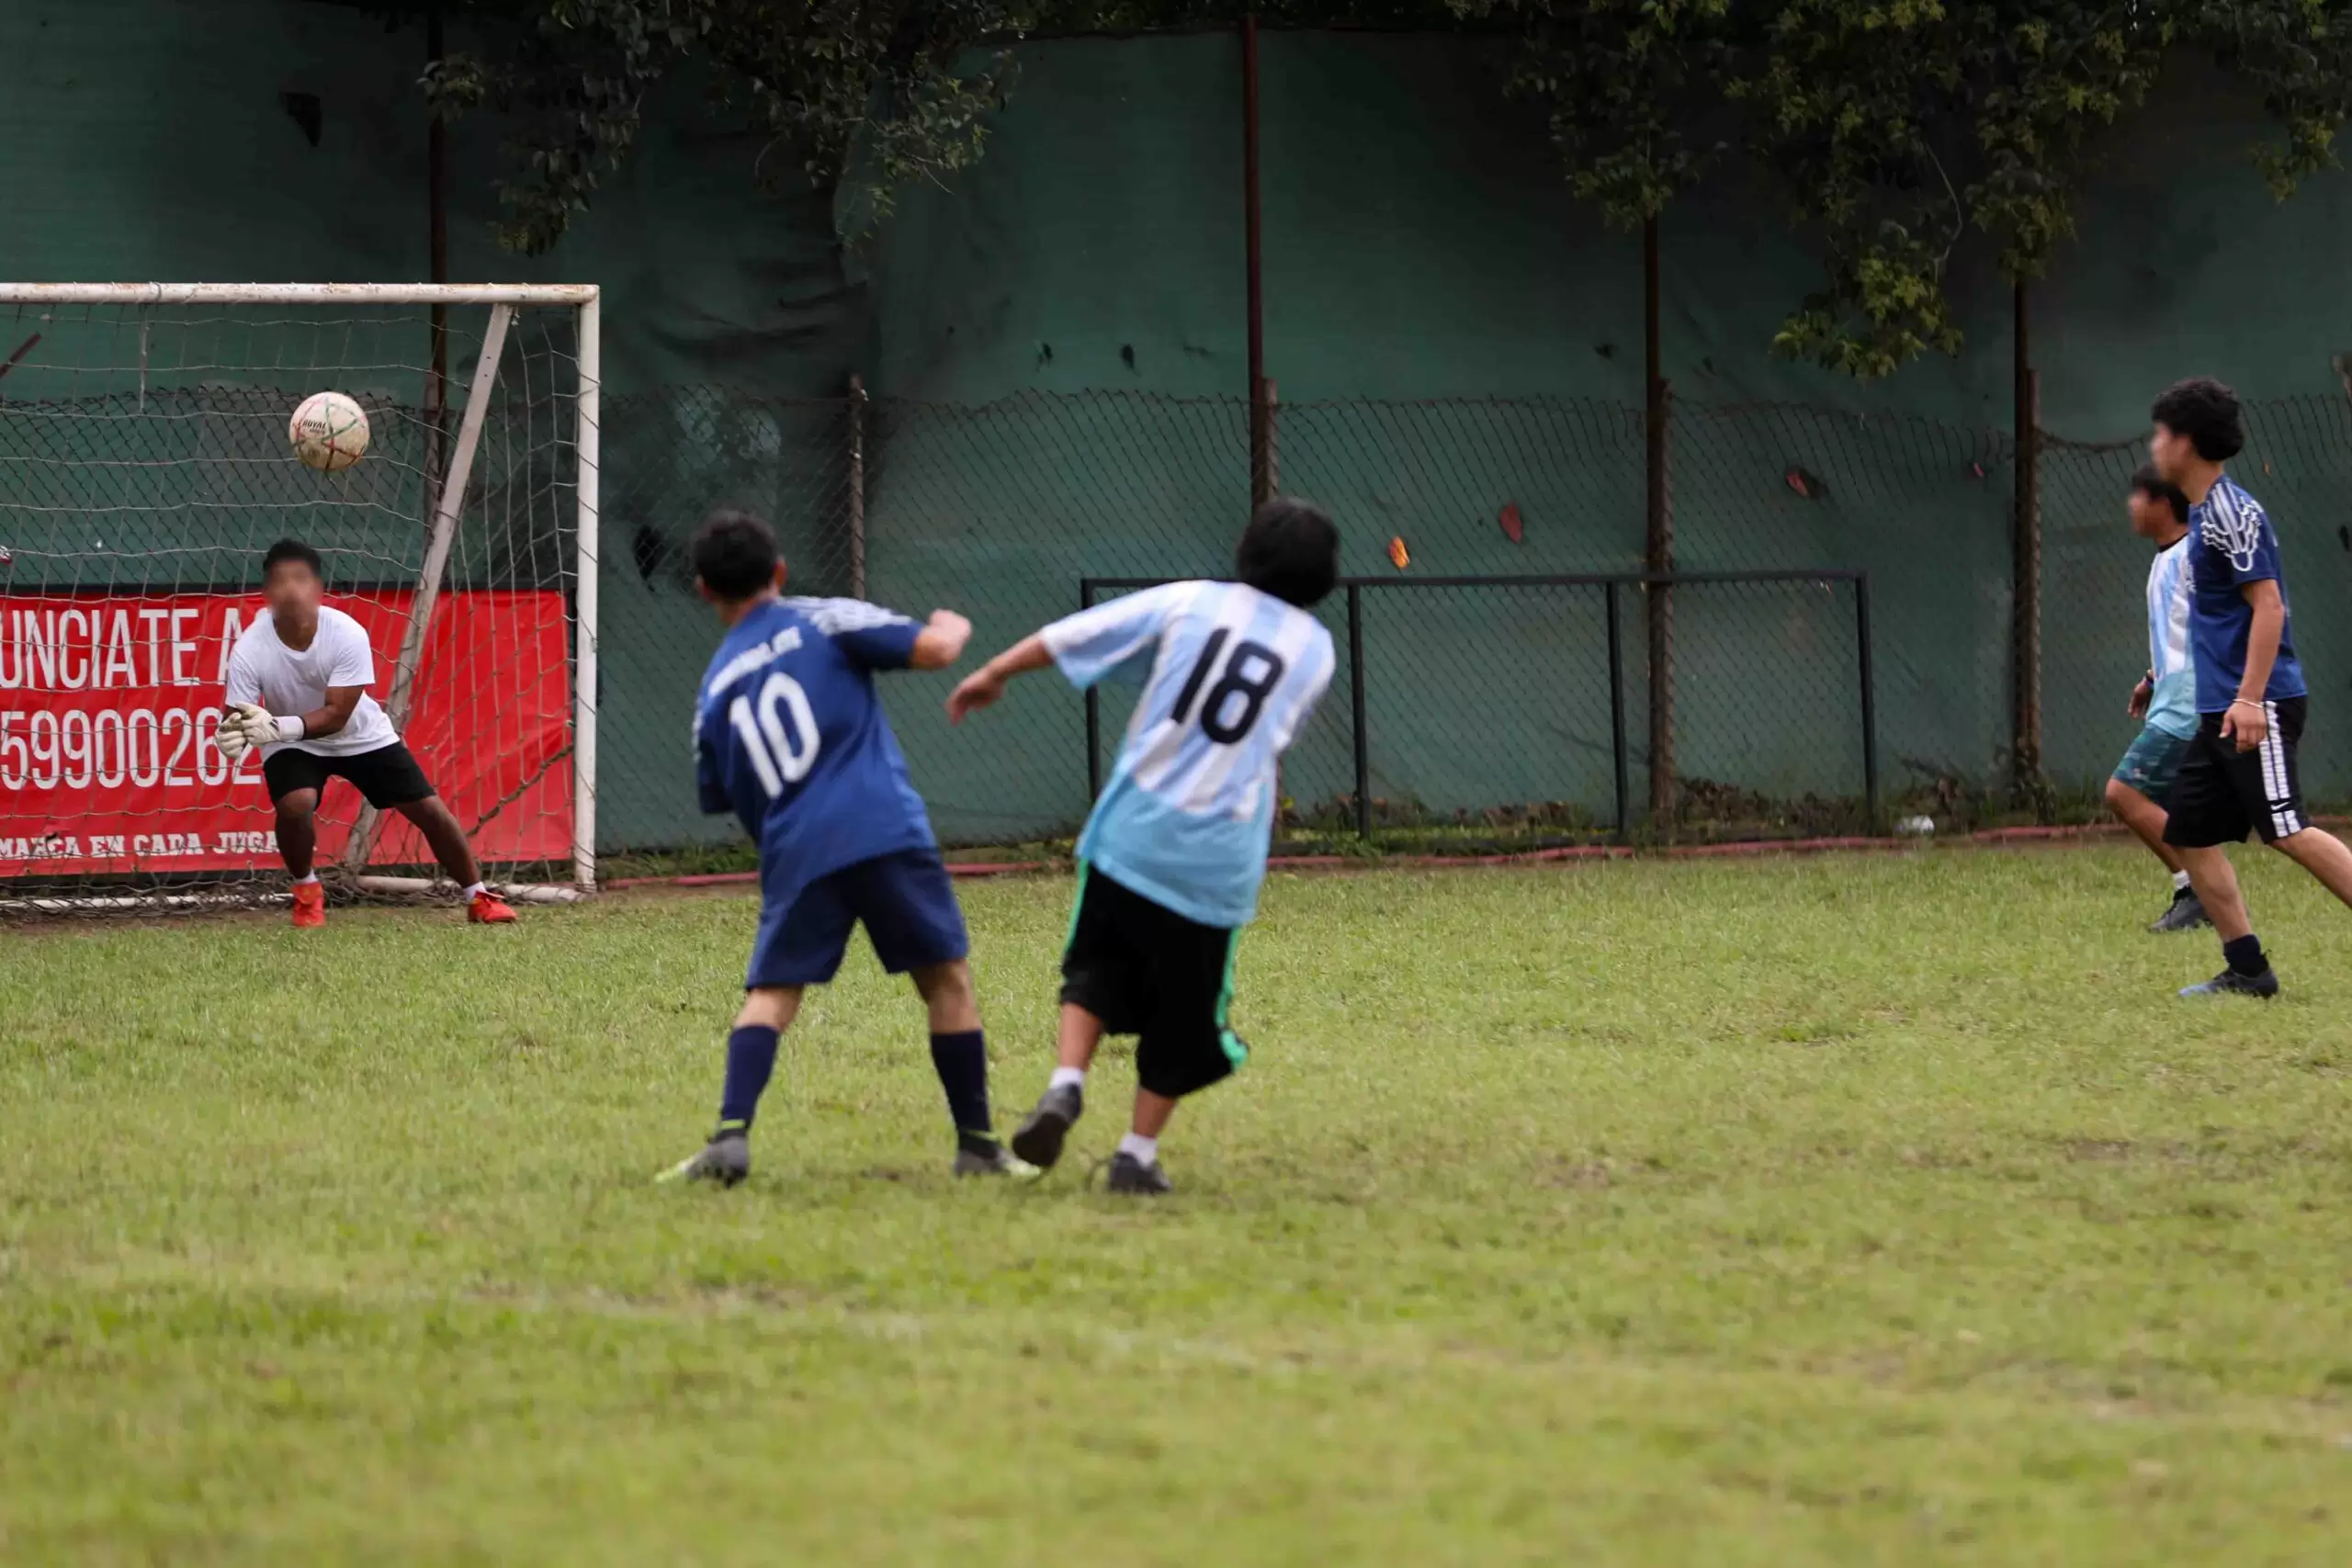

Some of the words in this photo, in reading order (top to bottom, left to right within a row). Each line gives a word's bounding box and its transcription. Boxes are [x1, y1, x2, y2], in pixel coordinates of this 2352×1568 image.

[218, 608, 267, 685] A
[1171, 626, 1284, 745] 18
[729, 671, 820, 798] 10
[89, 835, 125, 858] EN
[133, 833, 204, 857] CADA
[212, 830, 280, 854] JUGA
